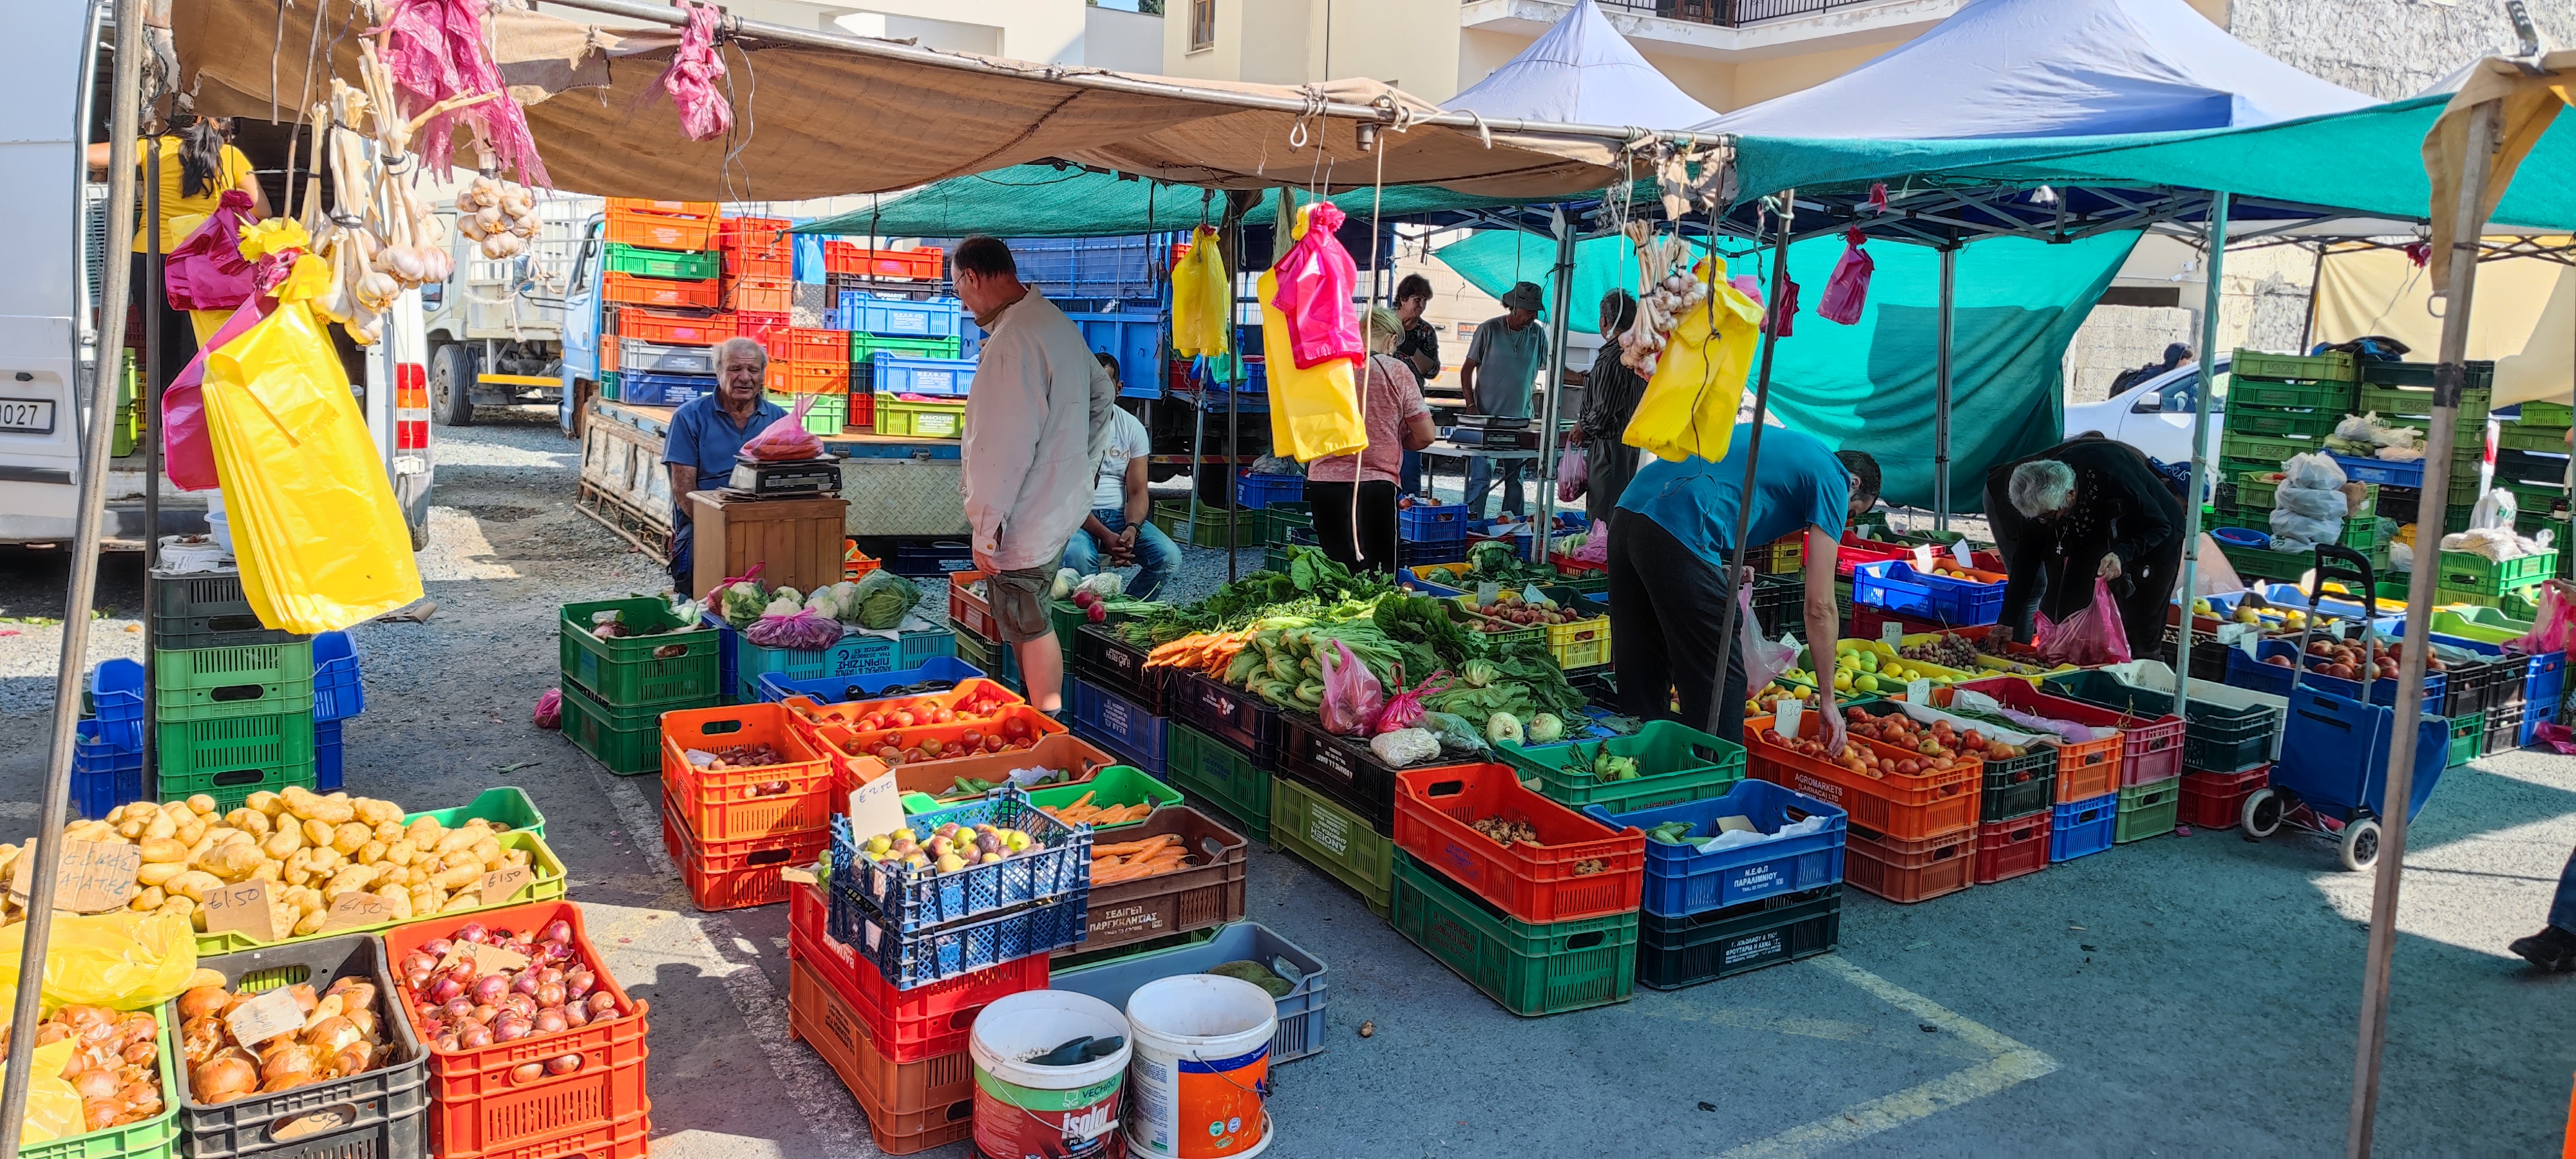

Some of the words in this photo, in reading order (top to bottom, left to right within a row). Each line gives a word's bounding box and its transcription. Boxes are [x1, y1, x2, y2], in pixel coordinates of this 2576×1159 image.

[0, 404, 37, 426] 027
[1781, 702, 1801, 717] 1.30
[1794, 773, 1842, 796] AGROMARKETS
[1798, 782, 1828, 798] (LARNACA)
[1829, 794, 1839, 802] LTD
[1311, 820, 1321, 830] ΛΤΔ
[1311, 825, 1347, 852] ΑΝΟΙΞΗ
[1321, 827, 1347, 845] ΔΗΜΟΣΙΑ
[58, 871, 132, 896] ΑΤΑΤΕΣ
[1734, 871, 1778, 888] ΠΑΡΑΛΙΜΝΙΟΥ
[209, 888, 260, 910] €1.50
[1105, 905, 1143, 919] ΣΕΔΙΓΕΠ
[1726, 944, 1752, 956] ΦΡΟΥΤΑΡΙΑ
[1737, 936, 1761, 947] ΝΙΚΟΛΑΟΥ
[1082, 1077, 1116, 1098] VECHRO
